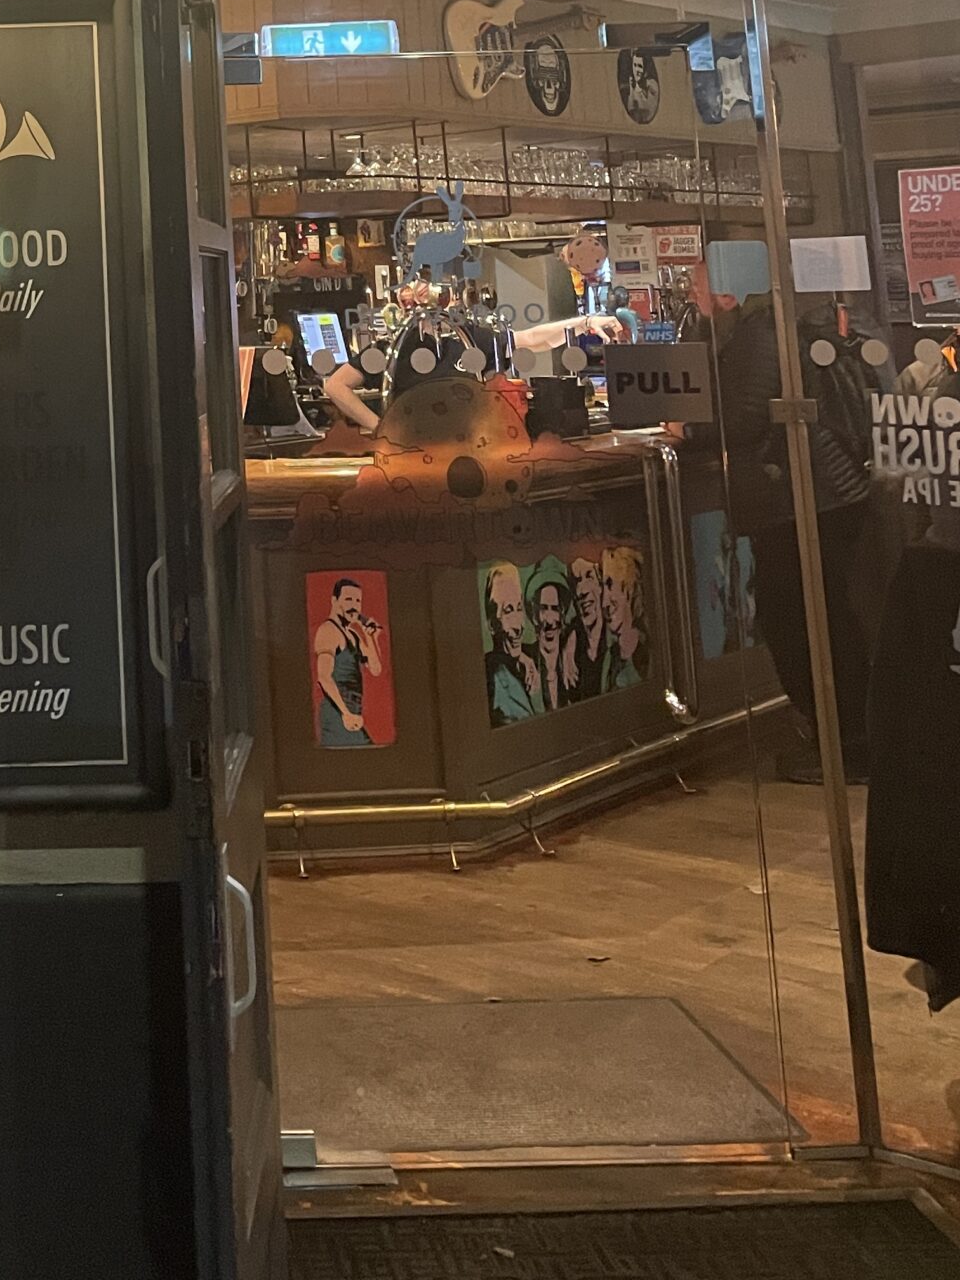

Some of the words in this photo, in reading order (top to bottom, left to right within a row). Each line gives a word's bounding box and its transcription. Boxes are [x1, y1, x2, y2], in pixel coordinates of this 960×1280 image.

[909, 194, 942, 212] 25?
[646, 331, 673, 341] NHS
[616, 372, 701, 395] PULL
